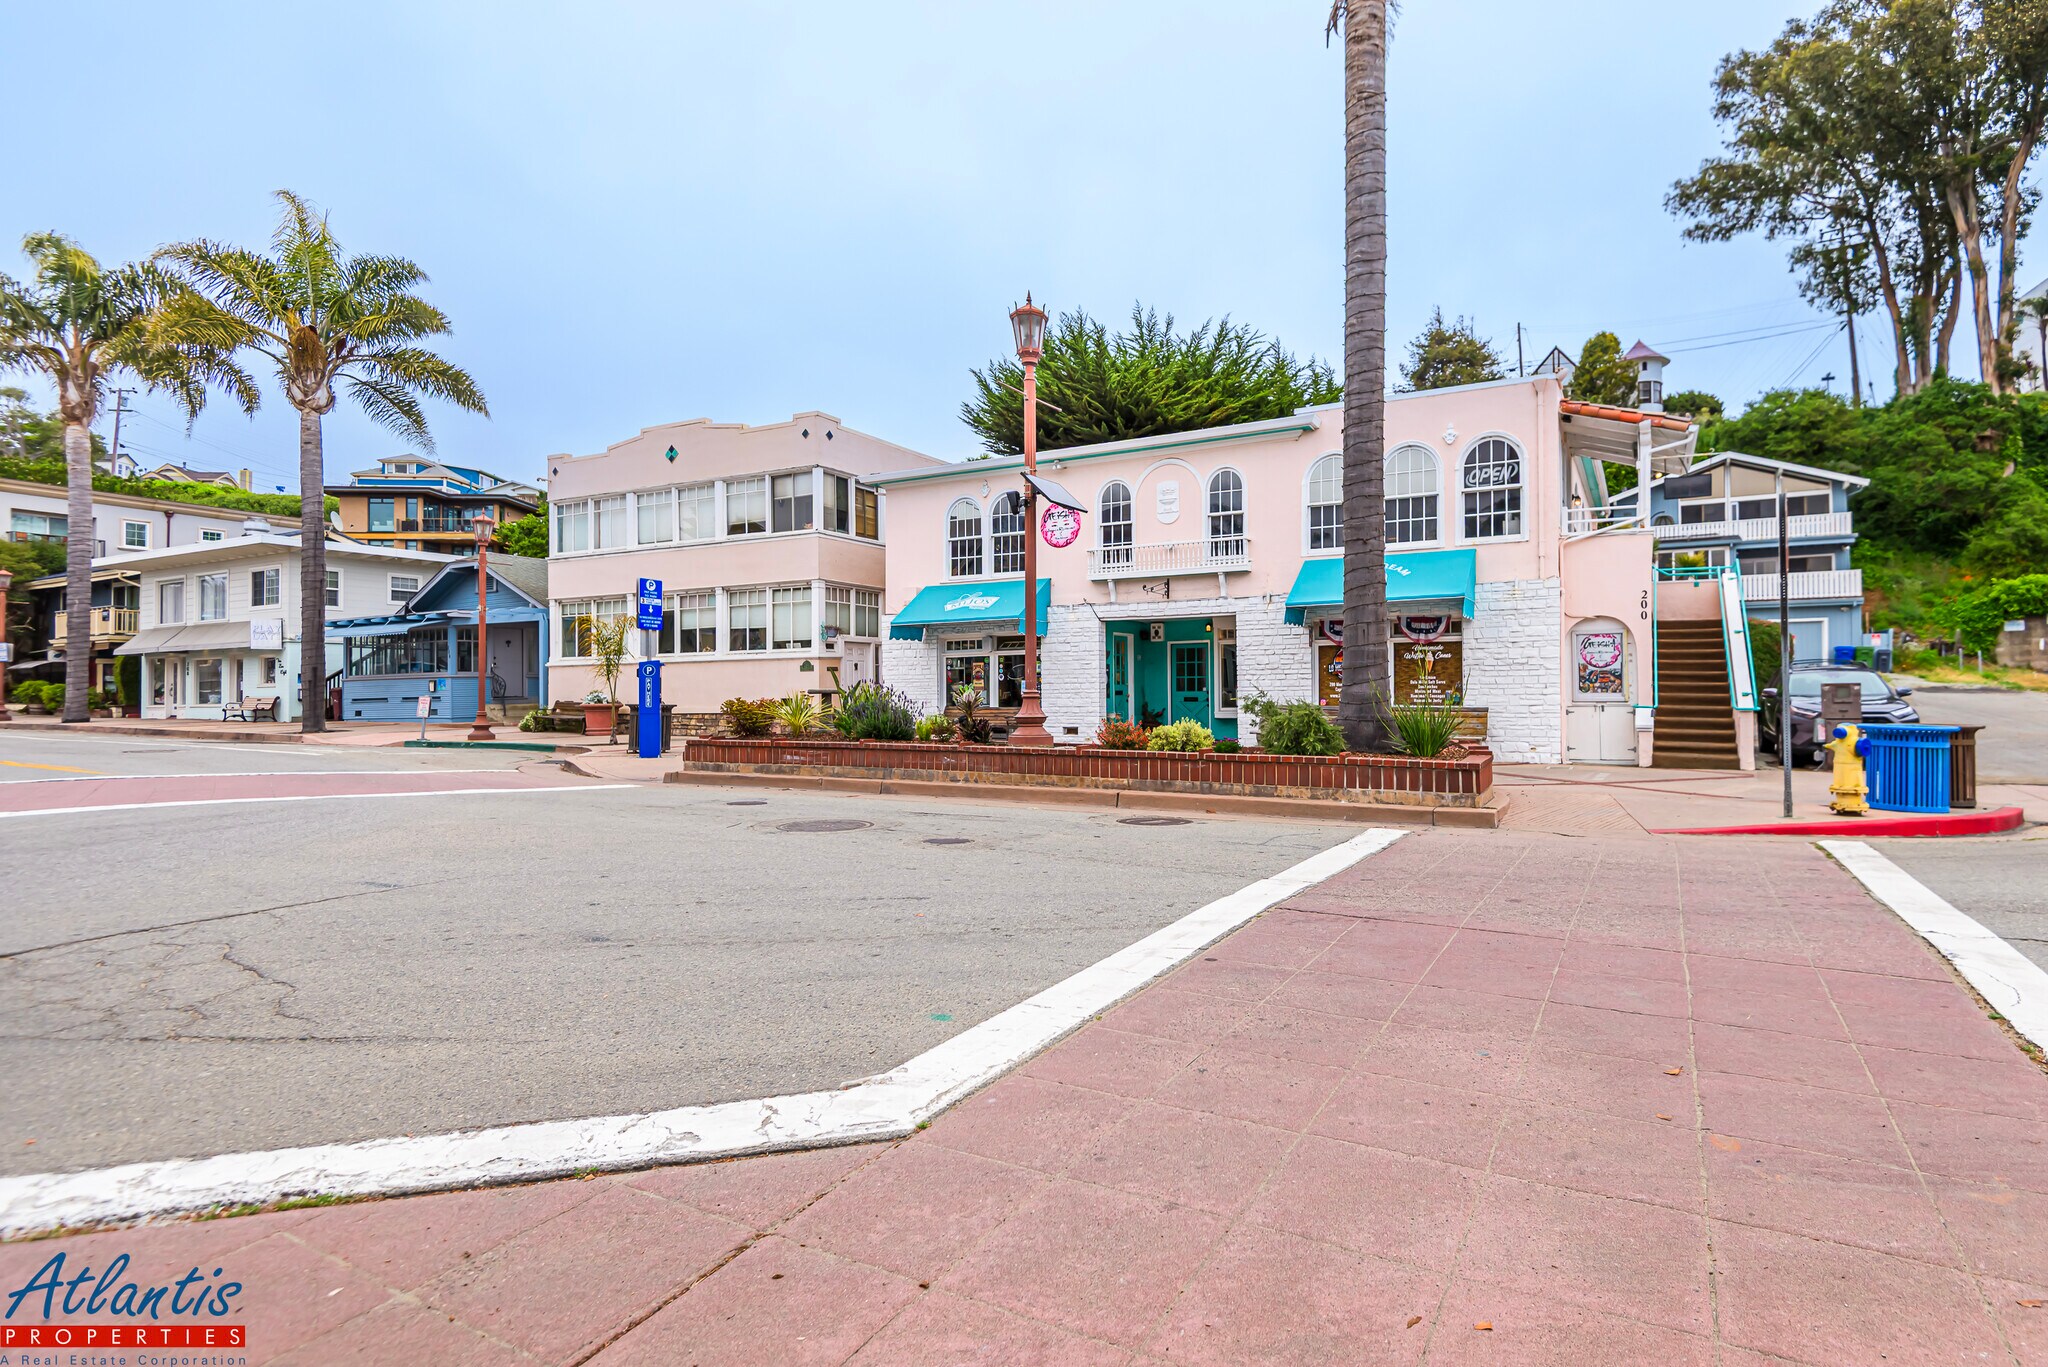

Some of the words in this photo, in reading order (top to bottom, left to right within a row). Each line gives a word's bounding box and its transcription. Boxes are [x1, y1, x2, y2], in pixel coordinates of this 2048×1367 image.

[1469, 466, 1513, 483] OPEN
[1384, 562, 1412, 577] REAM
[1640, 590, 1648, 620] 200
